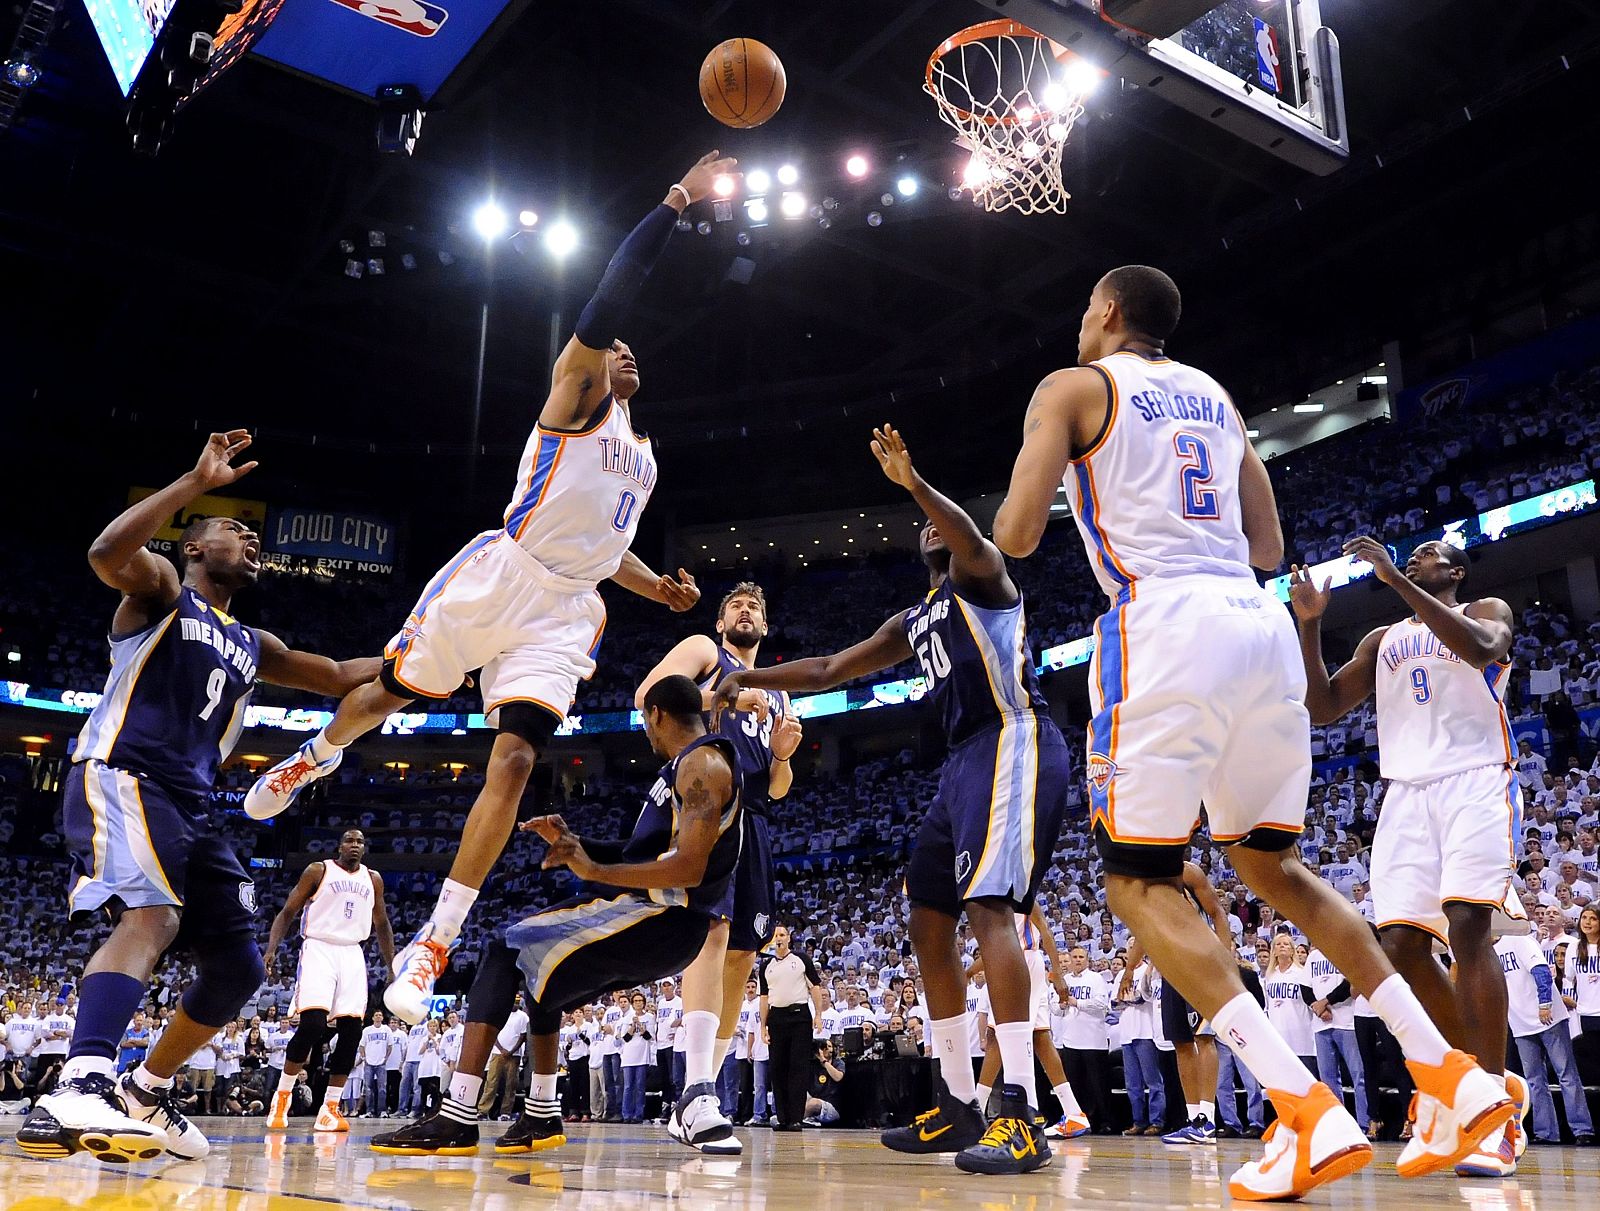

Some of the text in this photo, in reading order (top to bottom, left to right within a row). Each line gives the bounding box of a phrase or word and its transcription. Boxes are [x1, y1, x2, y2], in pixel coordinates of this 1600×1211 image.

[598, 436, 656, 492] THUND
[1173, 430, 1221, 520] 2
[611, 488, 637, 532] 0
[277, 514, 388, 555] LOUD CITY
[317, 557, 353, 571] EXIT
[356, 562, 393, 575] NOW
[180, 617, 256, 685] MEMPHIS
[916, 630, 952, 691] 50
[198, 668, 227, 721] 9
[1409, 666, 1433, 706] 9
[328, 880, 371, 901] THUNDER
[344, 900, 355, 920] 5
